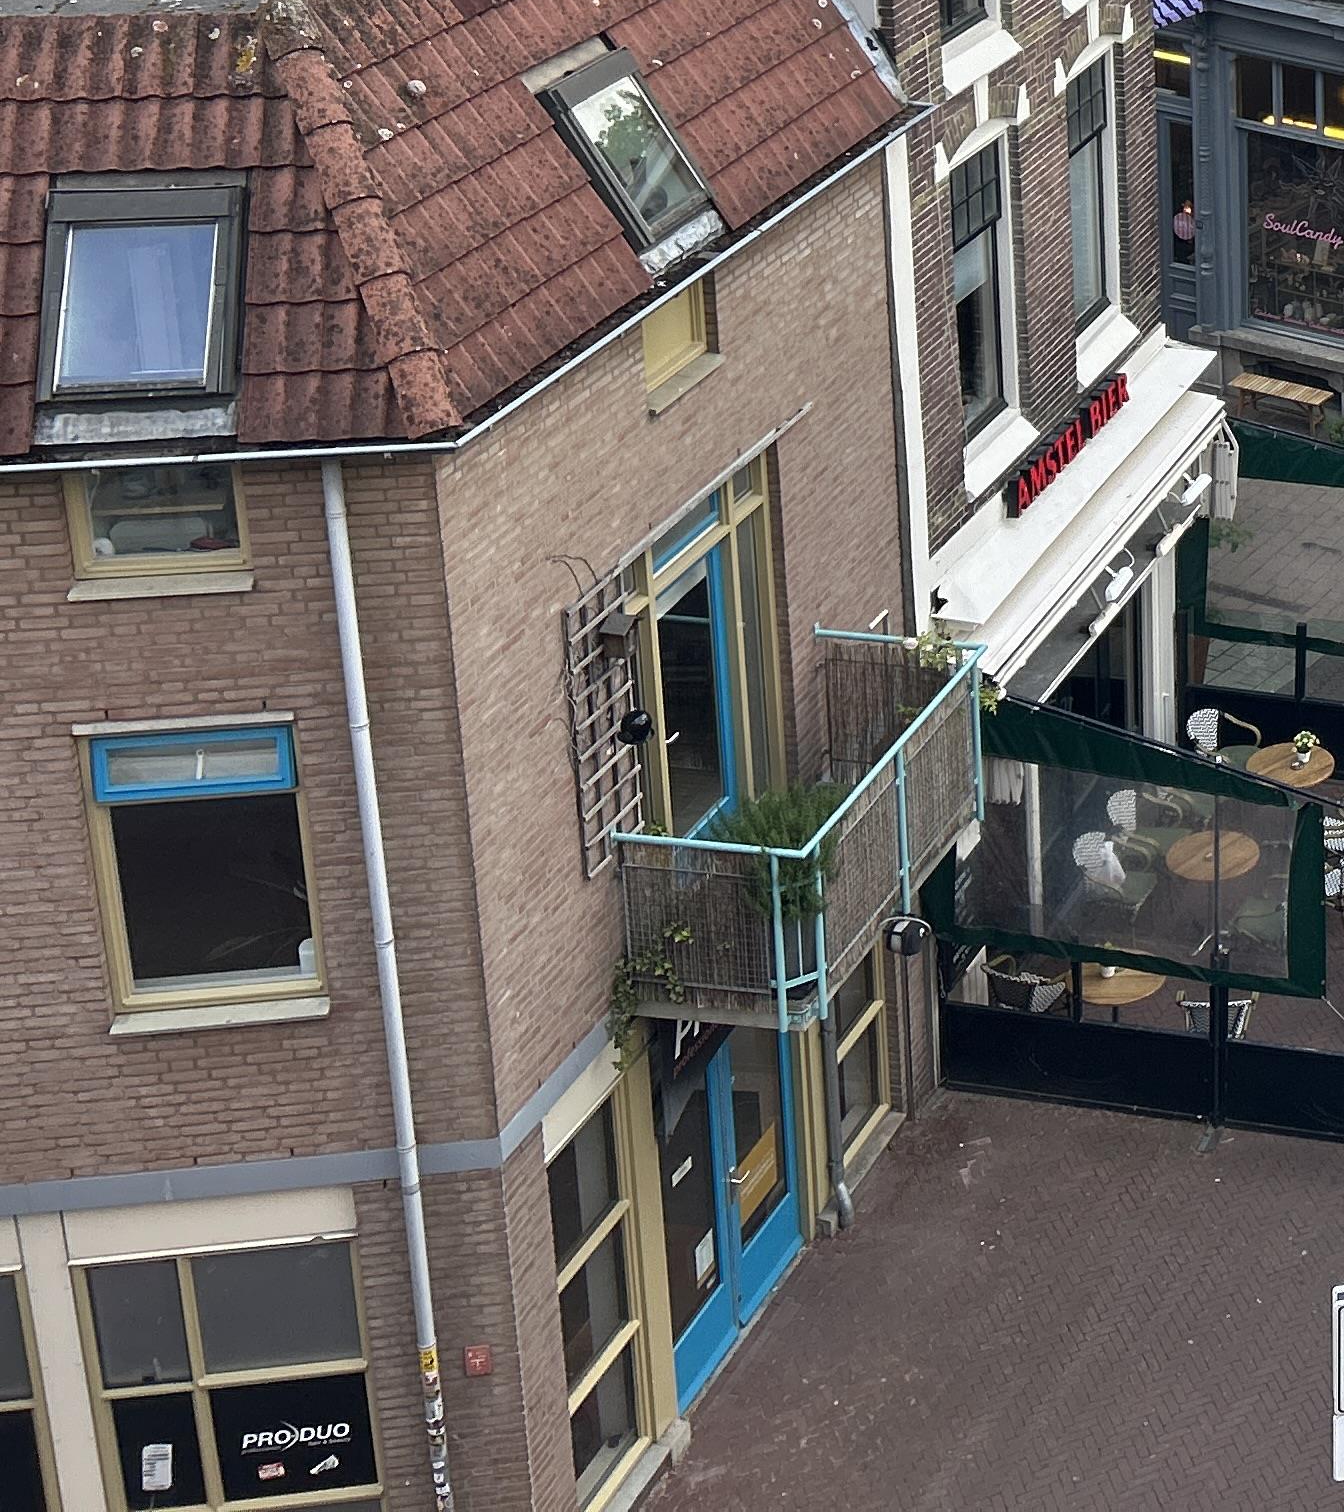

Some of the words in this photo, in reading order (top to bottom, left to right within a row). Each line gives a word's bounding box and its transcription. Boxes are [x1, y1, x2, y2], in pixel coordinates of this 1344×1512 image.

[1262, 213, 1344, 251] SoulCandy
[1017, 418, 1087, 514] AMSTEL
[1088, 372, 1131, 434] BIER
